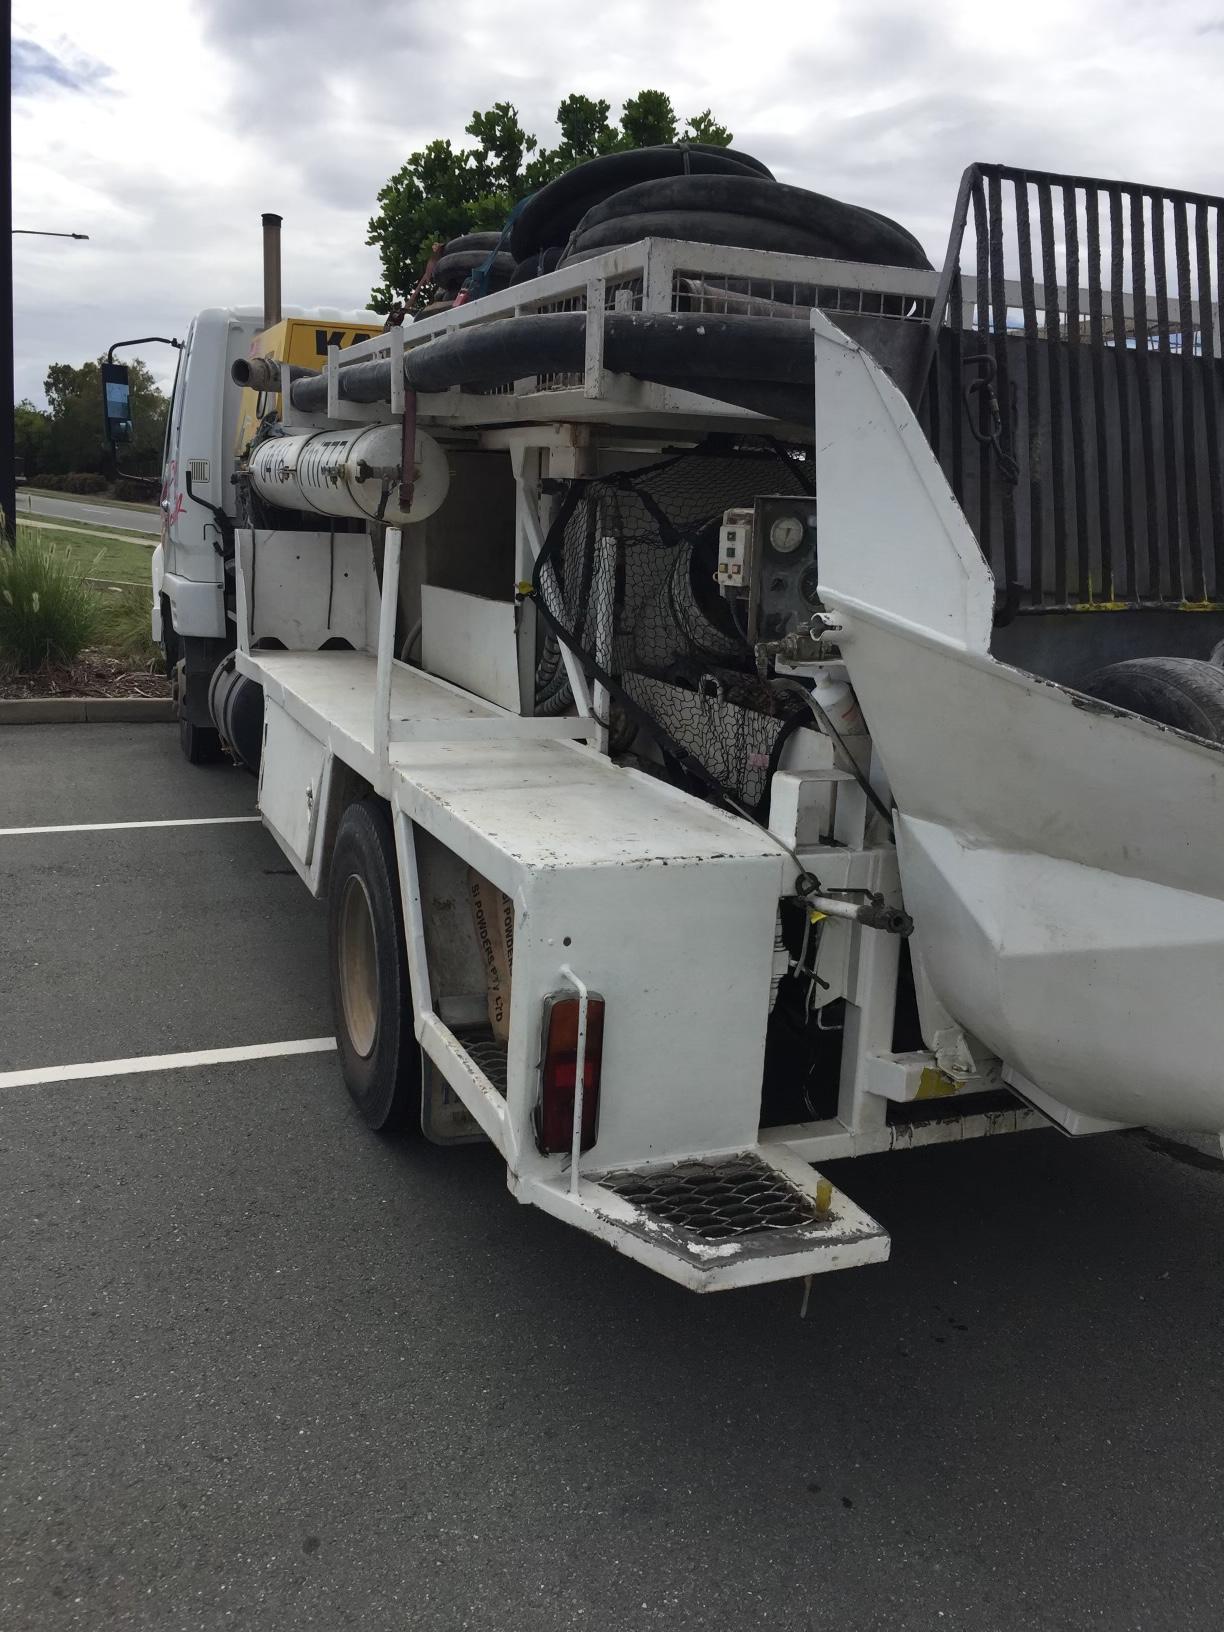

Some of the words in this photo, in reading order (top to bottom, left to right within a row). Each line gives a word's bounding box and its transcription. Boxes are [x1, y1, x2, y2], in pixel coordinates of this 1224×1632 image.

[474, 901, 495, 966] POWDERS
[490, 966, 500, 992] PTY
[495, 996, 503, 1022] LTD
[503, 907, 515, 977] POWDER
